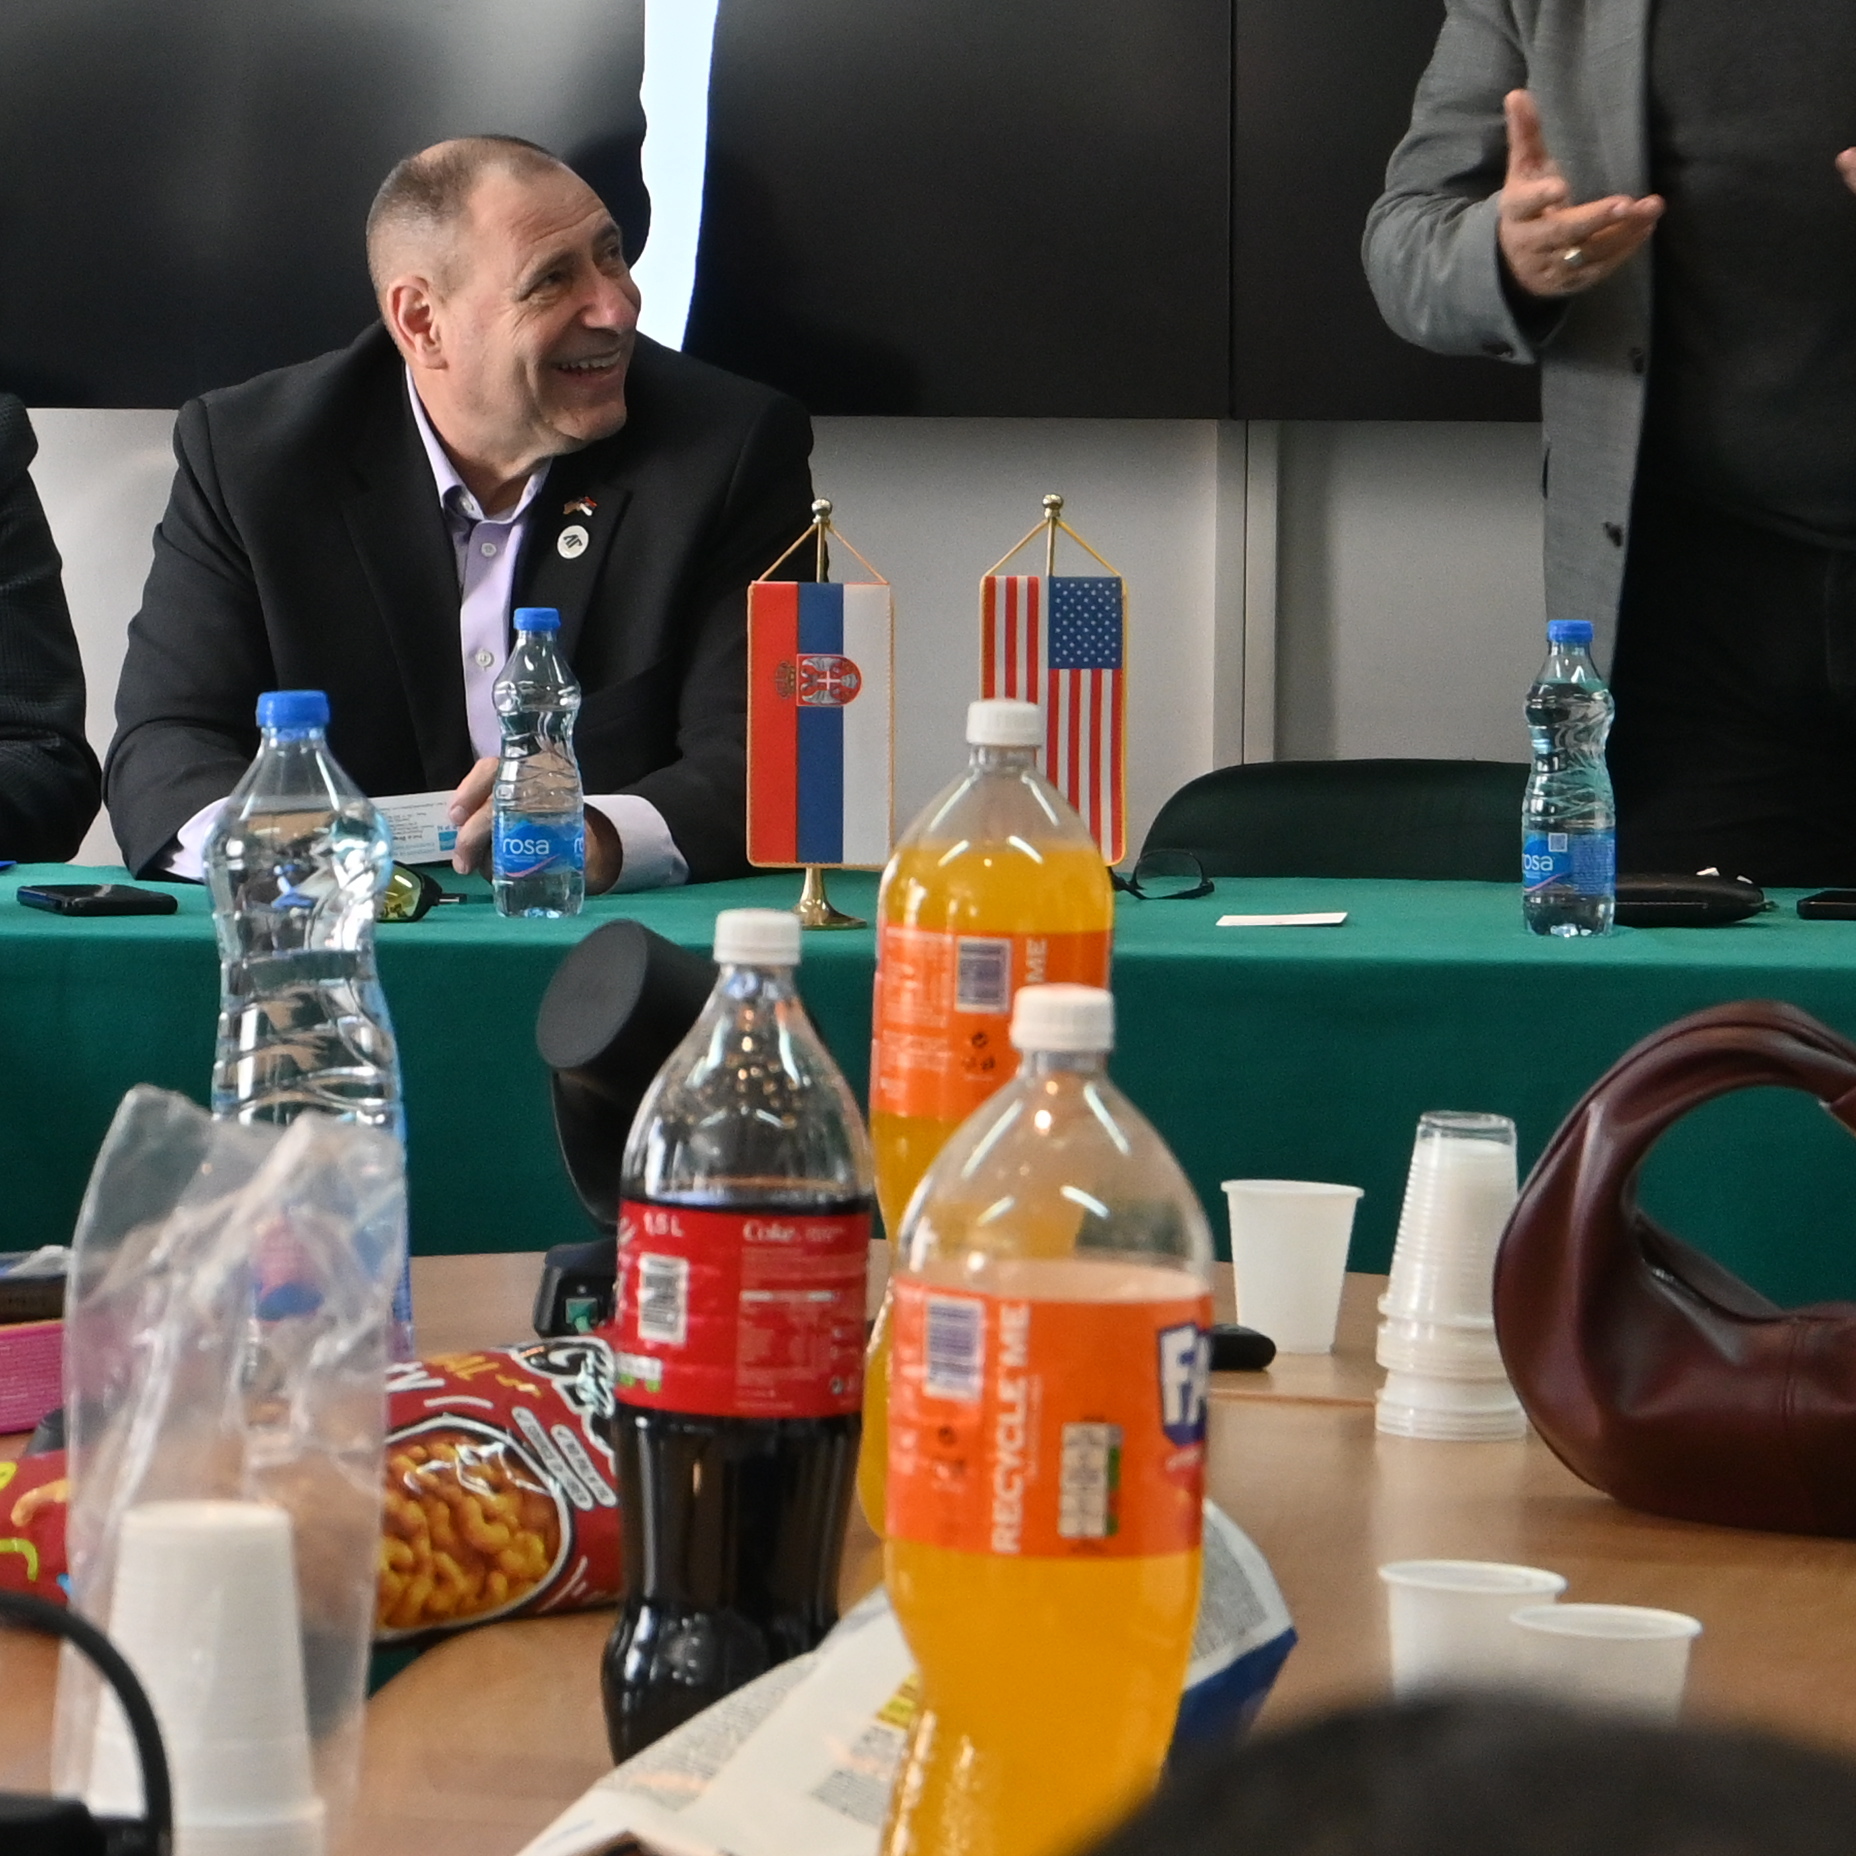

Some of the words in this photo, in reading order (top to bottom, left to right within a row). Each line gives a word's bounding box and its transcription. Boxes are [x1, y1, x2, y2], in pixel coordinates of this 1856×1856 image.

[502, 837, 550, 855] rosa
[670, 1215, 685, 1238] L
[999, 1302, 1031, 1367] ME
[991, 1374, 1028, 1554] RECYCLE
